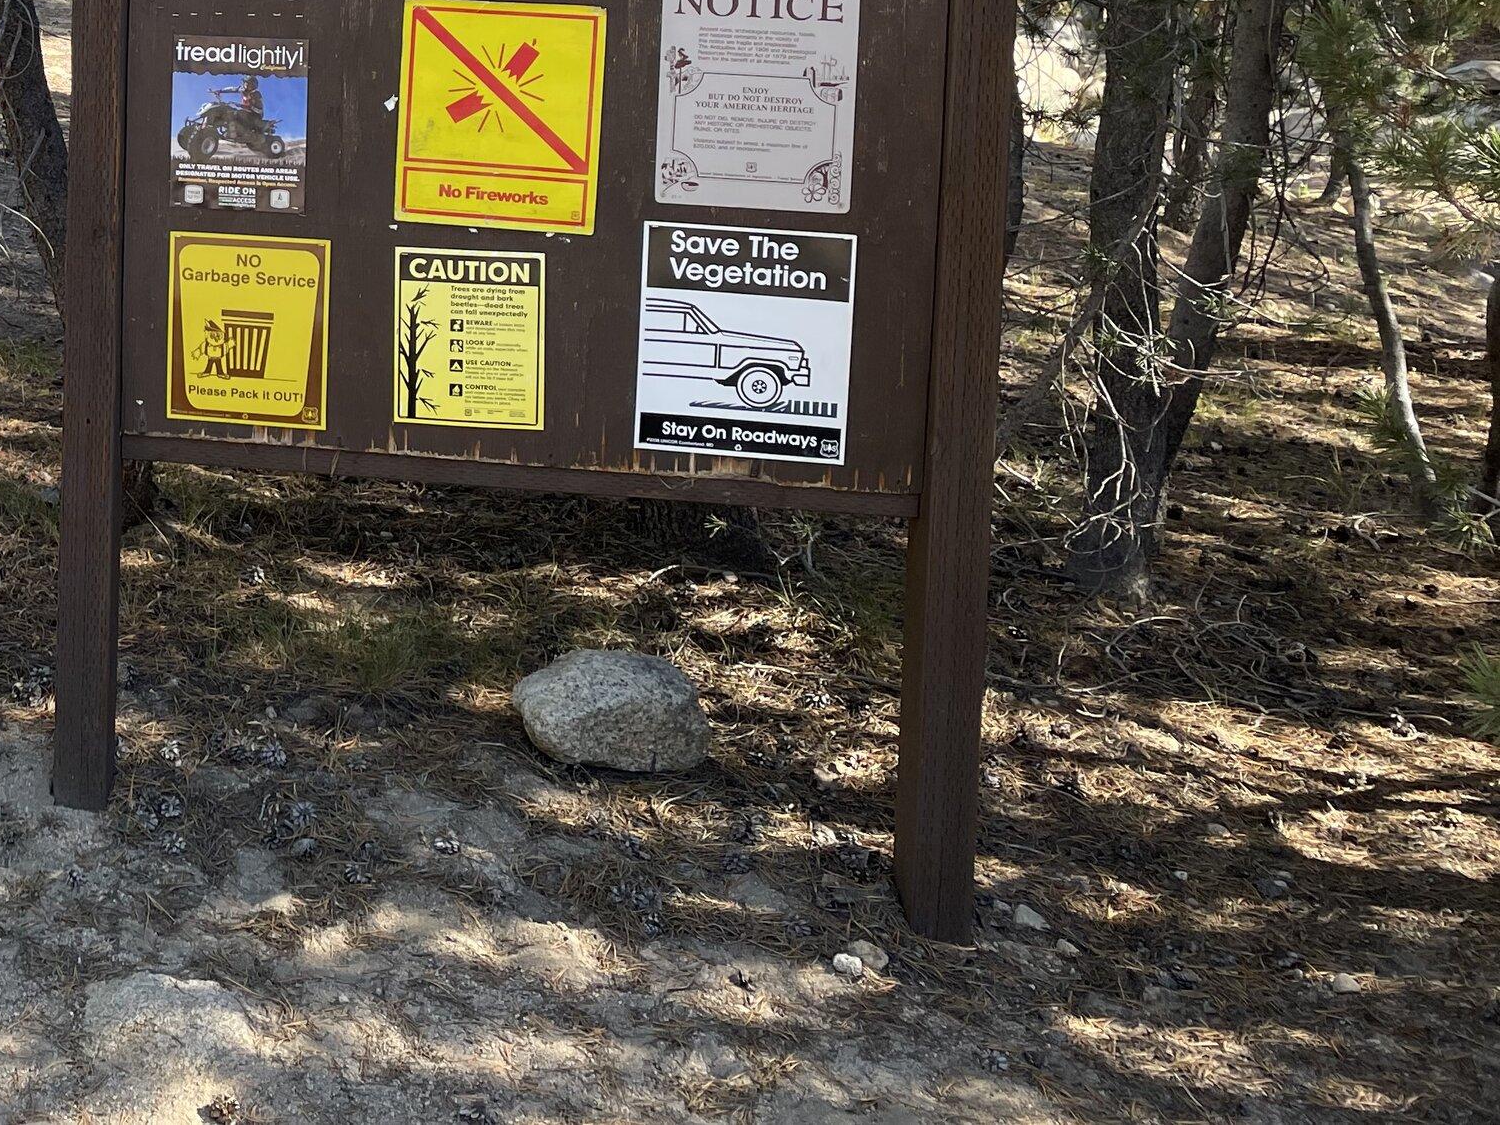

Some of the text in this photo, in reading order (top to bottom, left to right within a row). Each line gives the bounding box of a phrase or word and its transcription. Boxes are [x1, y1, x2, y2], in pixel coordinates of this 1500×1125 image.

[708, 93, 724, 101] BUT
[743, 95, 761, 103] NOT
[764, 96, 804, 105] DESTROY
[695, 100, 814, 114] YOUR AMERICAN HERITAGE
[175, 170, 216, 178] DESIGNATED
[231, 172, 255, 180] MOTOR
[233, 165, 259, 173] ROUTES
[218, 186, 256, 195] RIDE ON
[439, 184, 549, 206] No Fireworks
[670, 230, 800, 261] Save The
[236, 254, 261, 268] NO
[182, 267, 316, 288] Garbage Service
[409, 257, 530, 284] CAUTION
[669, 257, 827, 291] Vegetation
[450, 293, 479, 302] drought
[486, 287, 507, 295] dying
[479, 310, 528, 319] unexpectedly
[188, 385, 227, 397] Please
[231, 387, 258, 400] Pack
[273, 390, 303, 403] OUT!
[661, 421, 818, 449] Stay On Roadways
